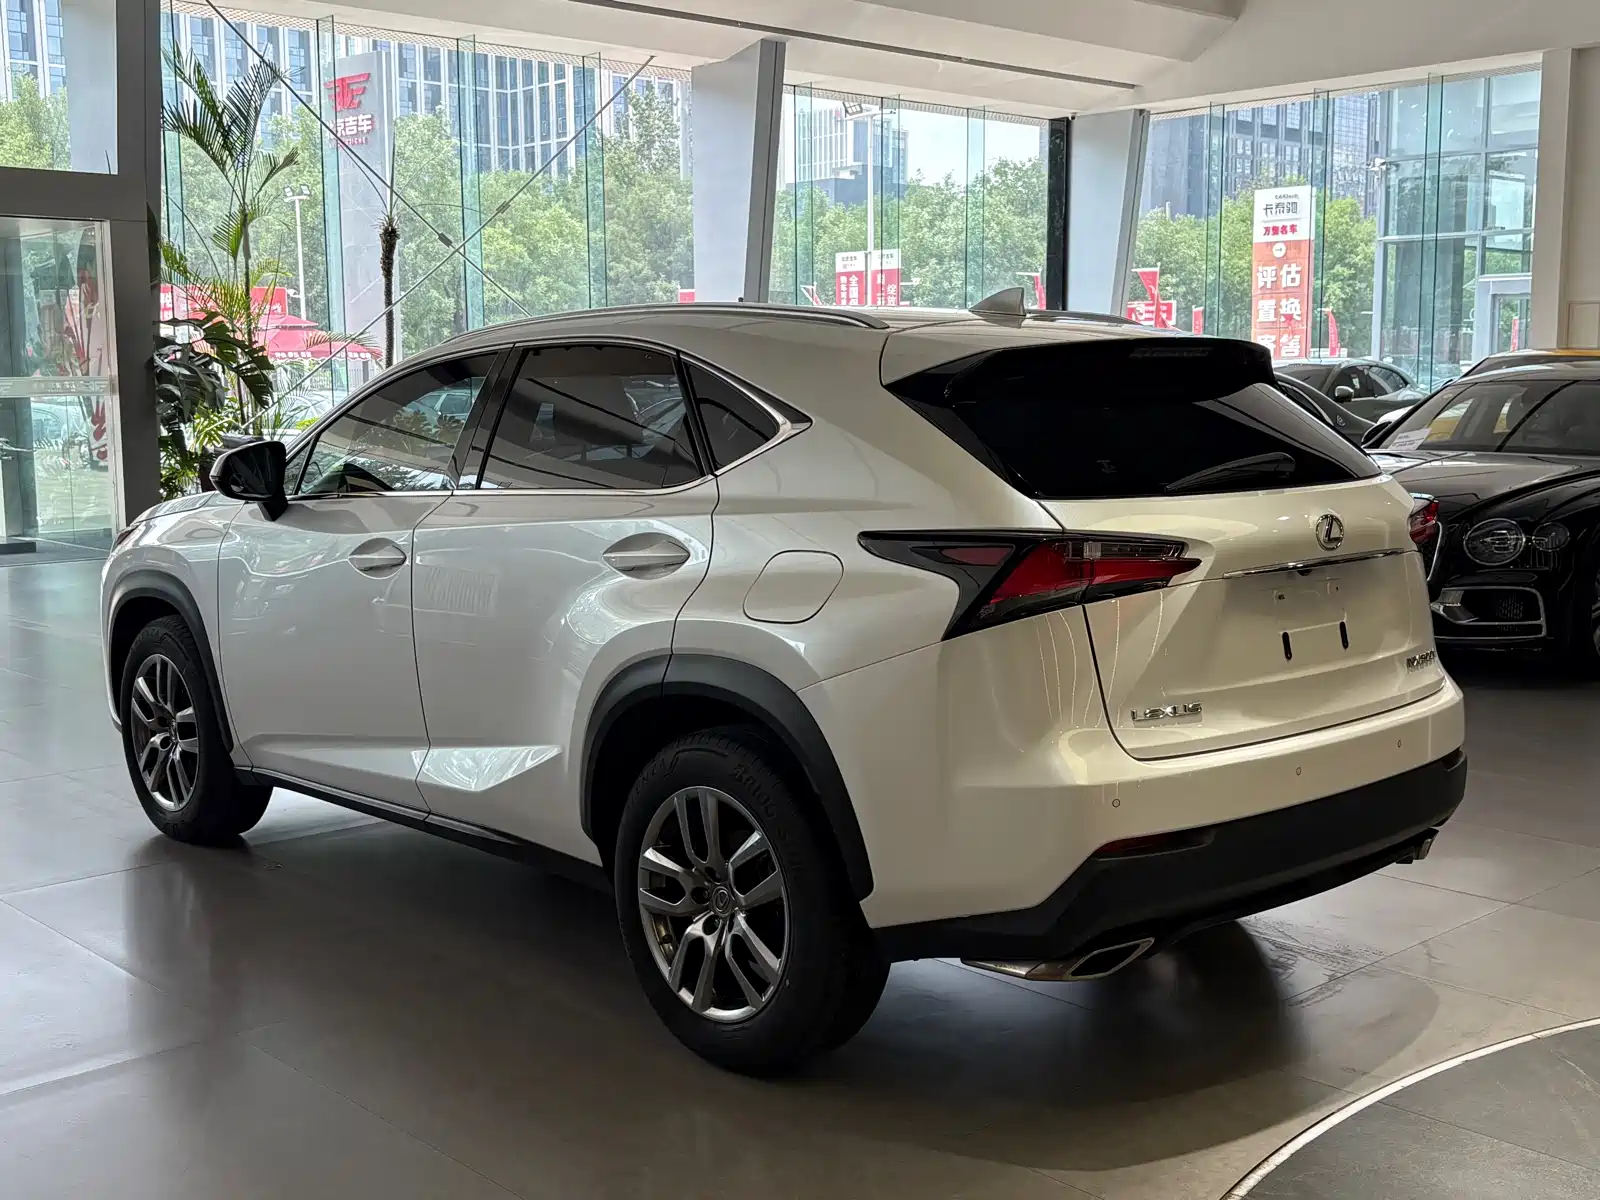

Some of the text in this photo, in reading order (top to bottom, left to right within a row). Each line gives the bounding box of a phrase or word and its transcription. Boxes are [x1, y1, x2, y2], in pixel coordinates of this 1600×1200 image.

[1257, 263, 1302, 289] 评估
[1257, 298, 1301, 322] 置换
[1130, 702, 1203, 722] LEXUS
